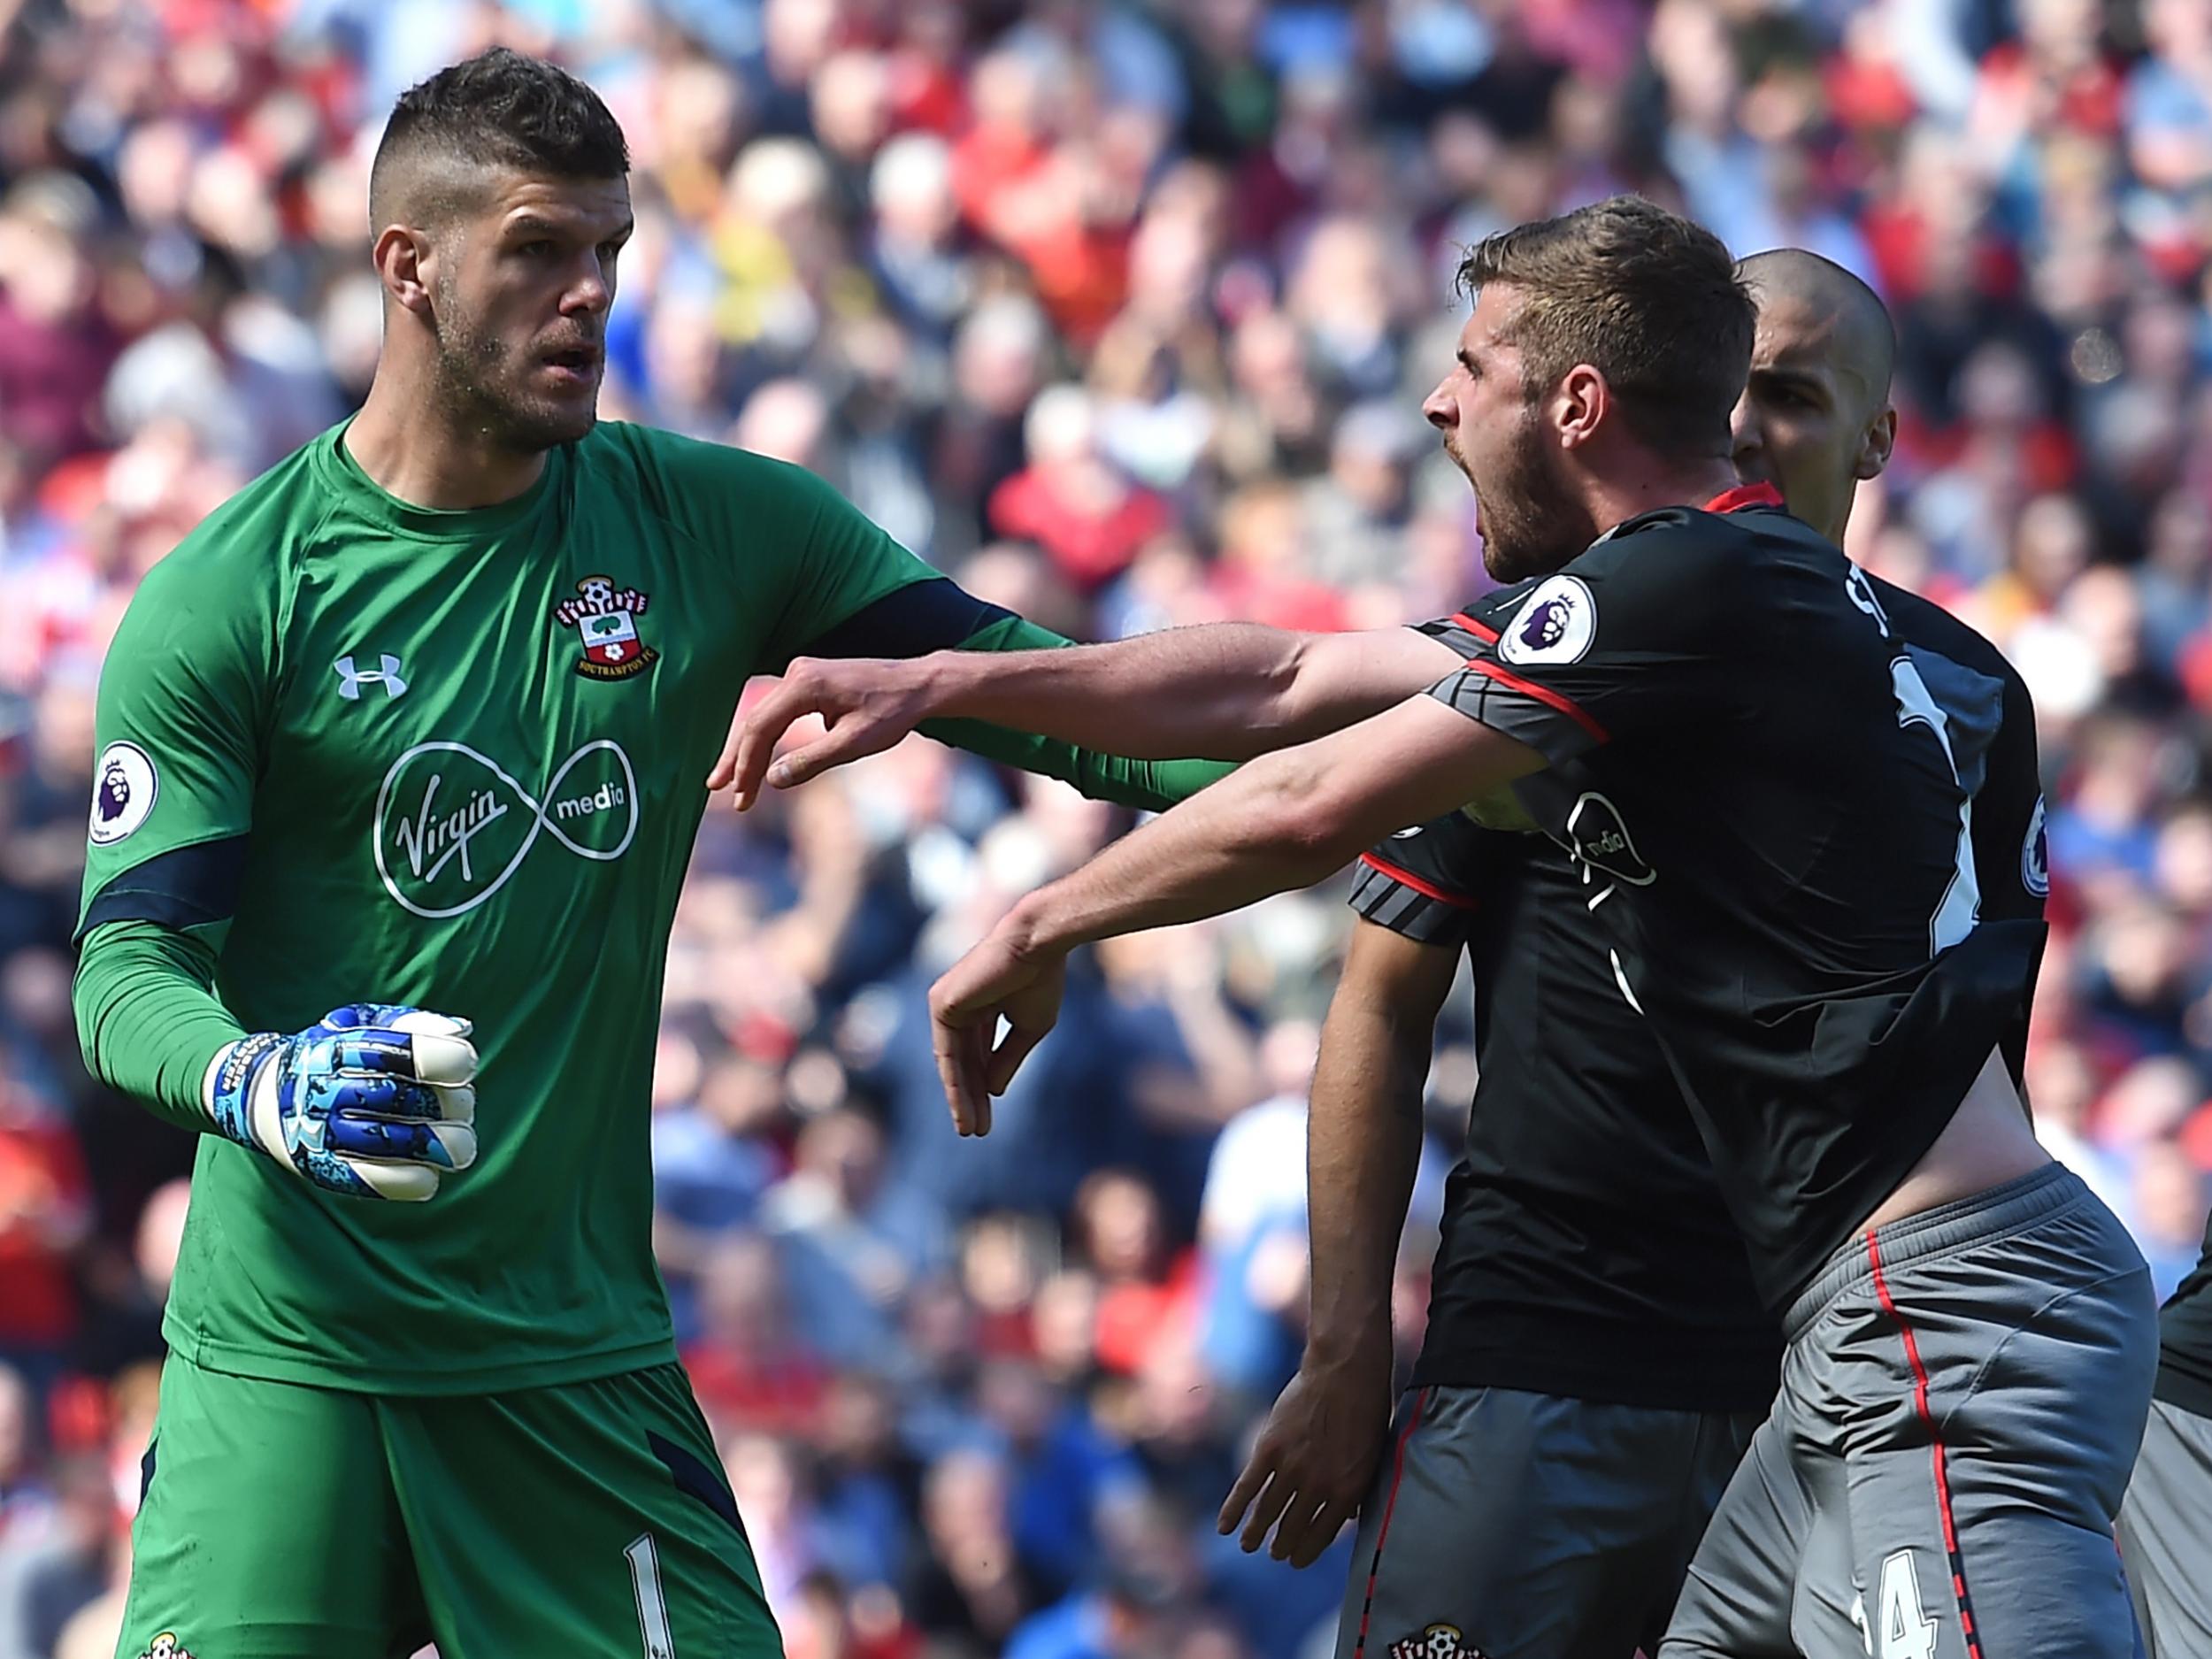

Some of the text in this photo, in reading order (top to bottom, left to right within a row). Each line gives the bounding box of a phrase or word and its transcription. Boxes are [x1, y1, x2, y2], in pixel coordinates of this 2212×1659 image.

[396, 773, 625, 882] Virgin media
[623, 1532, 676, 1659] 1
